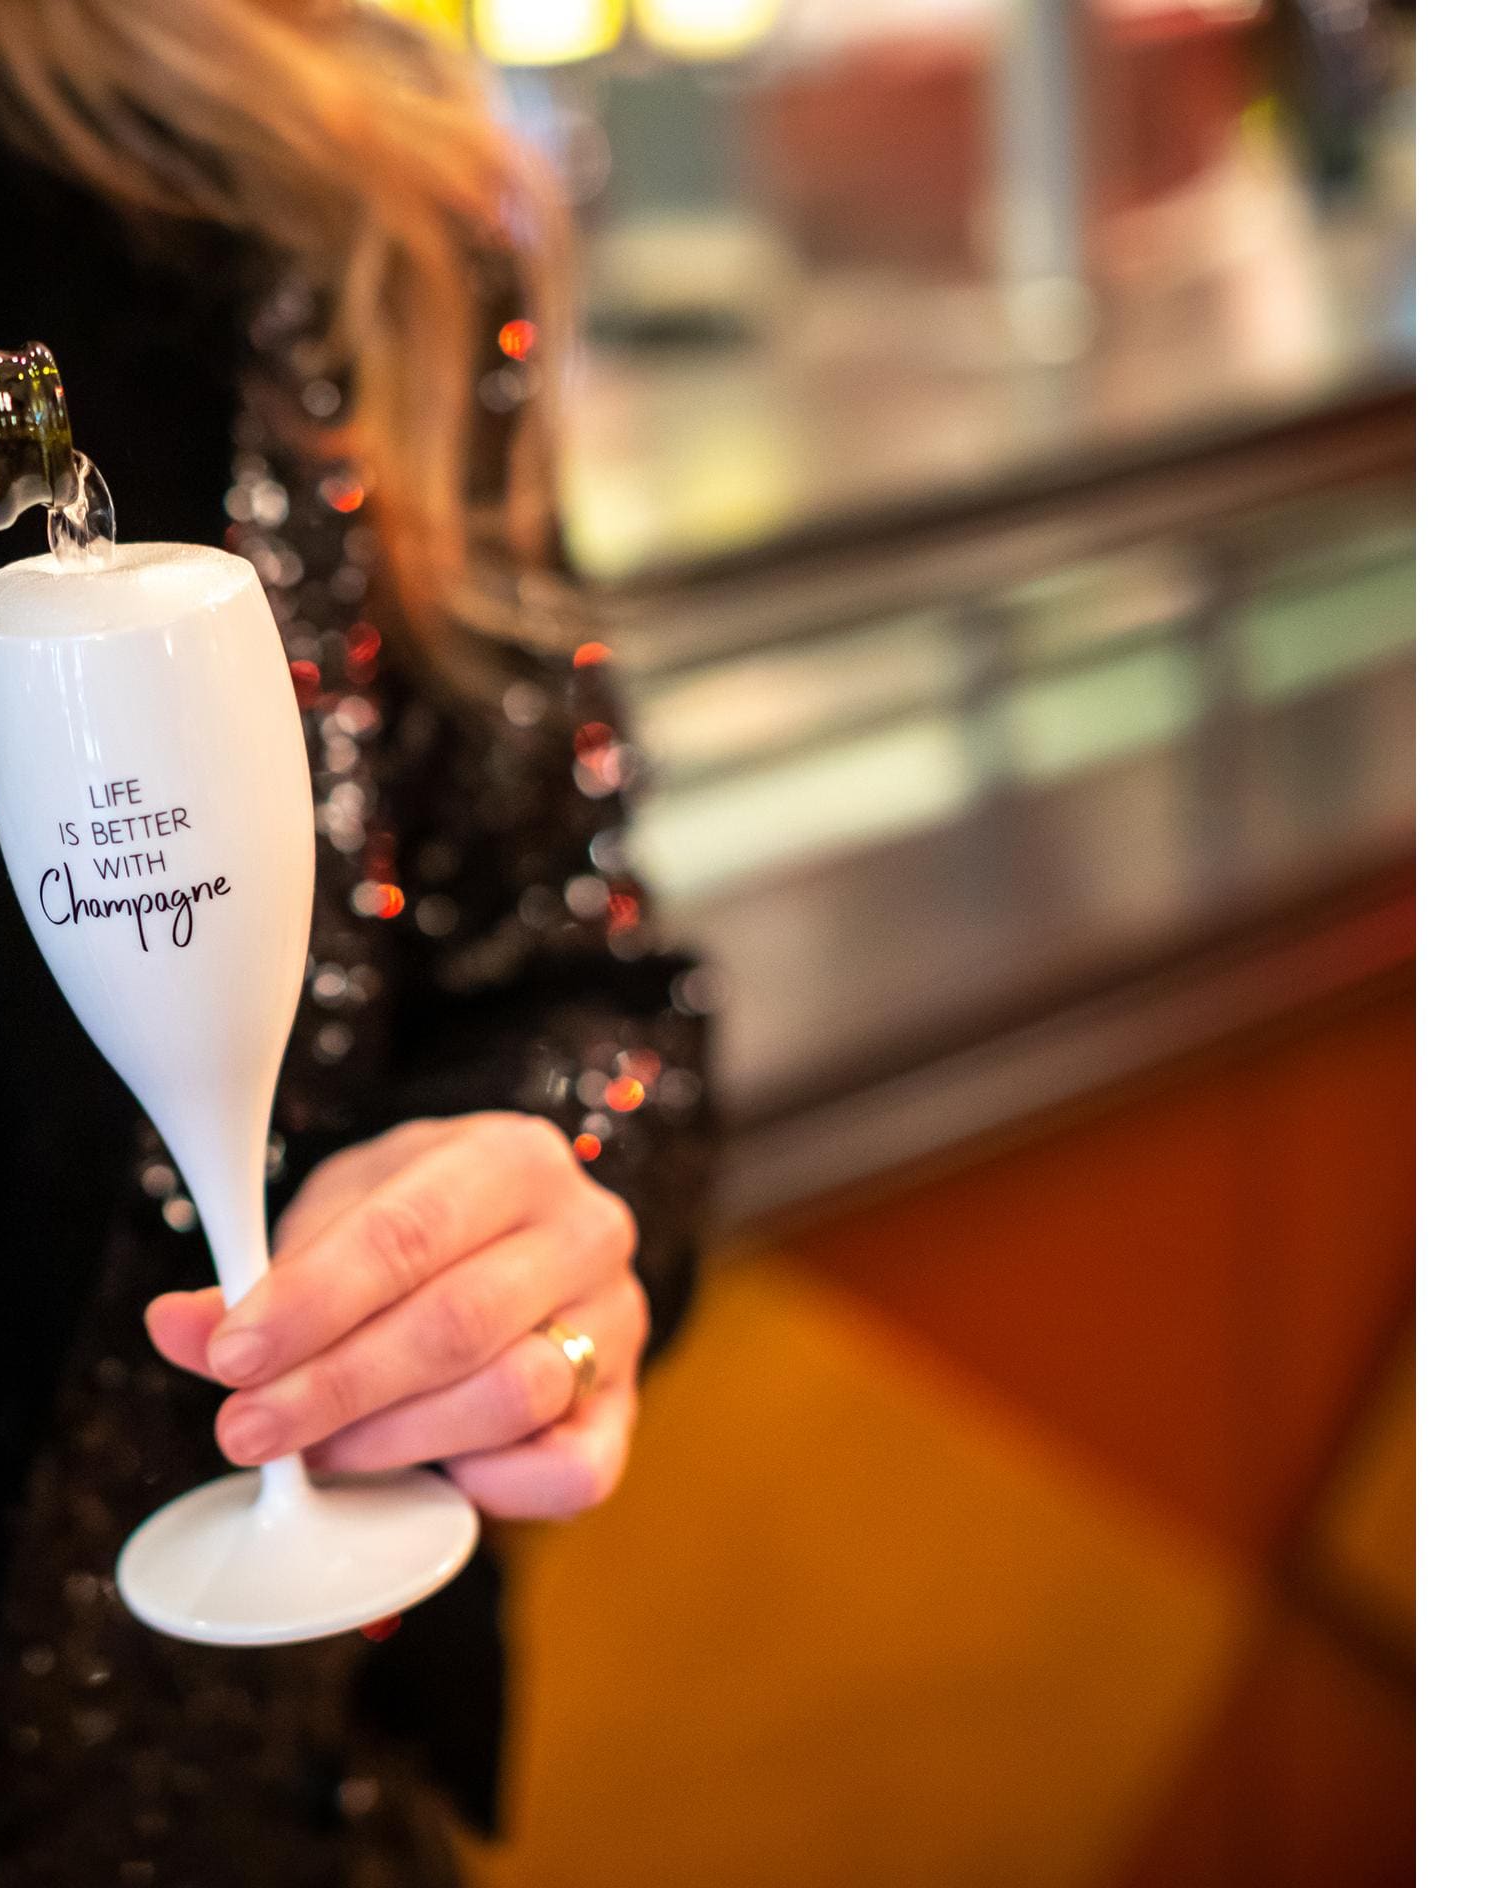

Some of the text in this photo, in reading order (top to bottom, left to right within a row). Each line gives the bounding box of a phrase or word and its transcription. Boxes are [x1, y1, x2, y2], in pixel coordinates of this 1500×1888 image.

[88, 778, 143, 809] LIFE
[58, 806, 192, 847] IS BETTER
[92, 849, 167, 880] WITH
[39, 861, 232, 953] Champagne
